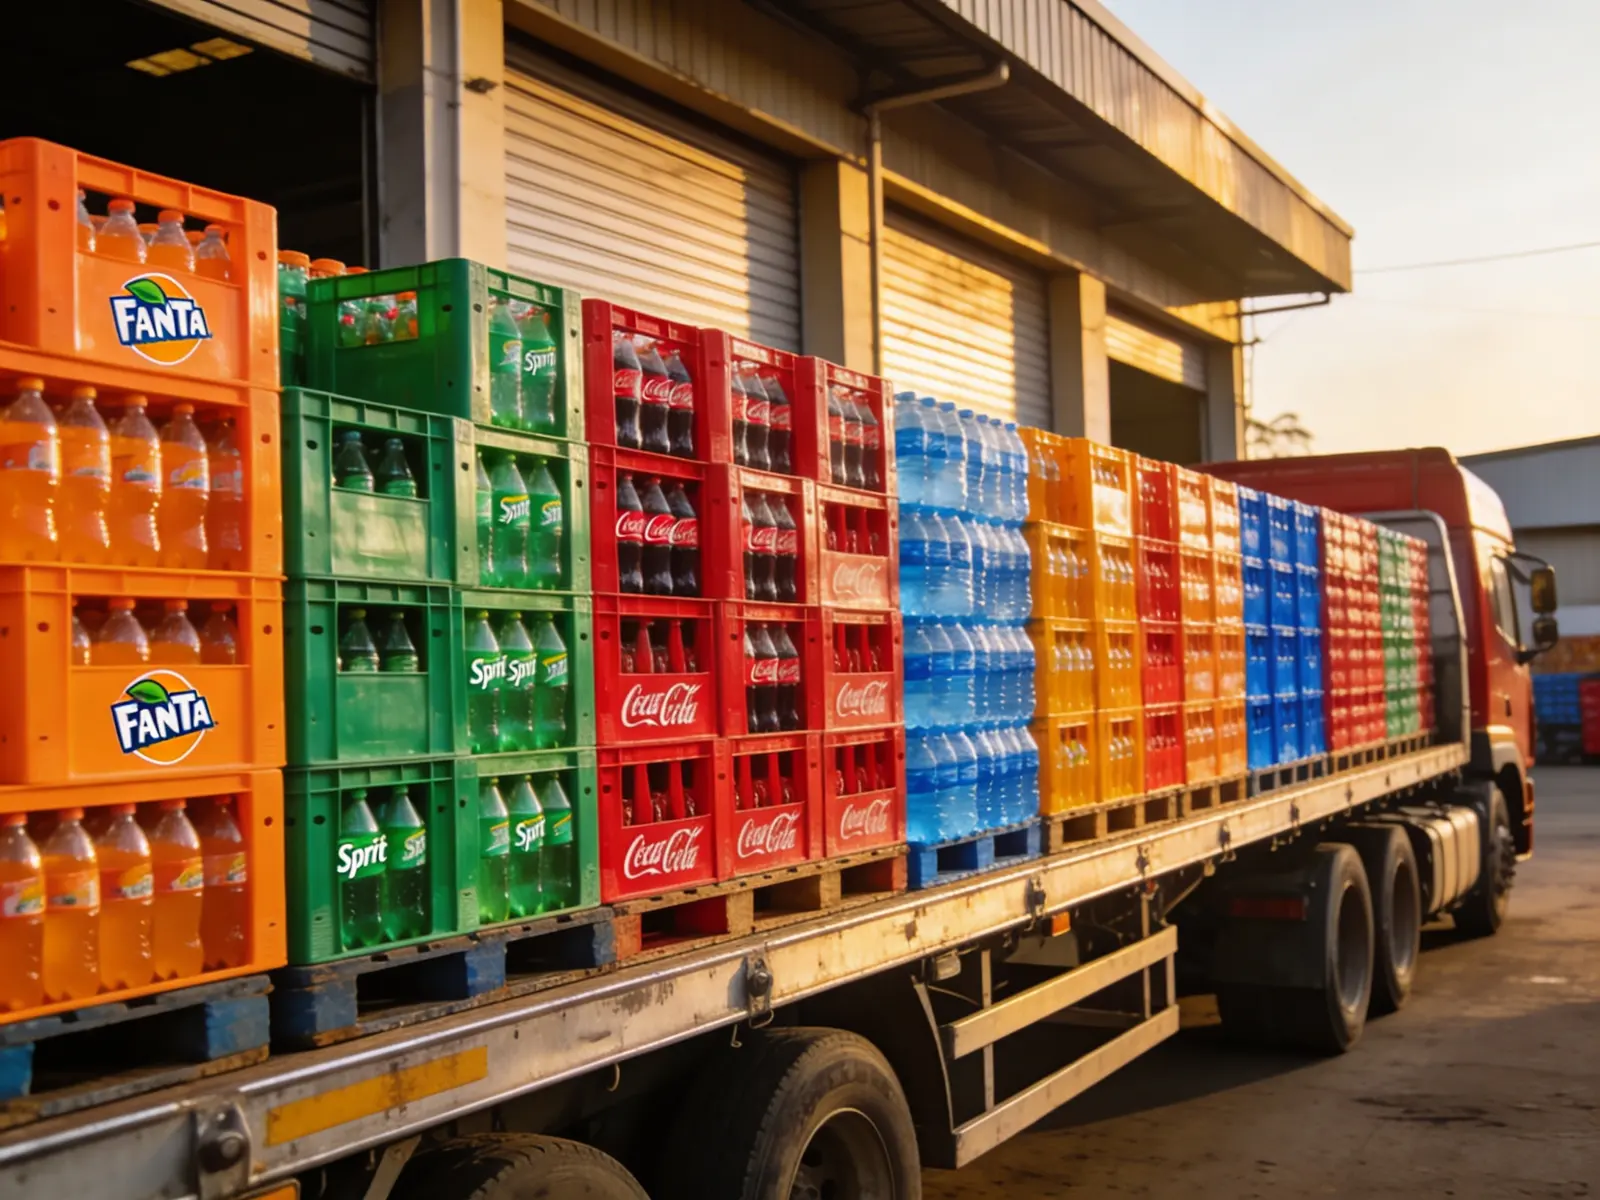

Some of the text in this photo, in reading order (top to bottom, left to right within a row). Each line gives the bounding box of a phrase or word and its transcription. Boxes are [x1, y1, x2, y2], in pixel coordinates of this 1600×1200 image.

[112, 298, 209, 342] FANTA
[113, 692, 212, 750] FANTA
[336, 834, 388, 879] Sprit
